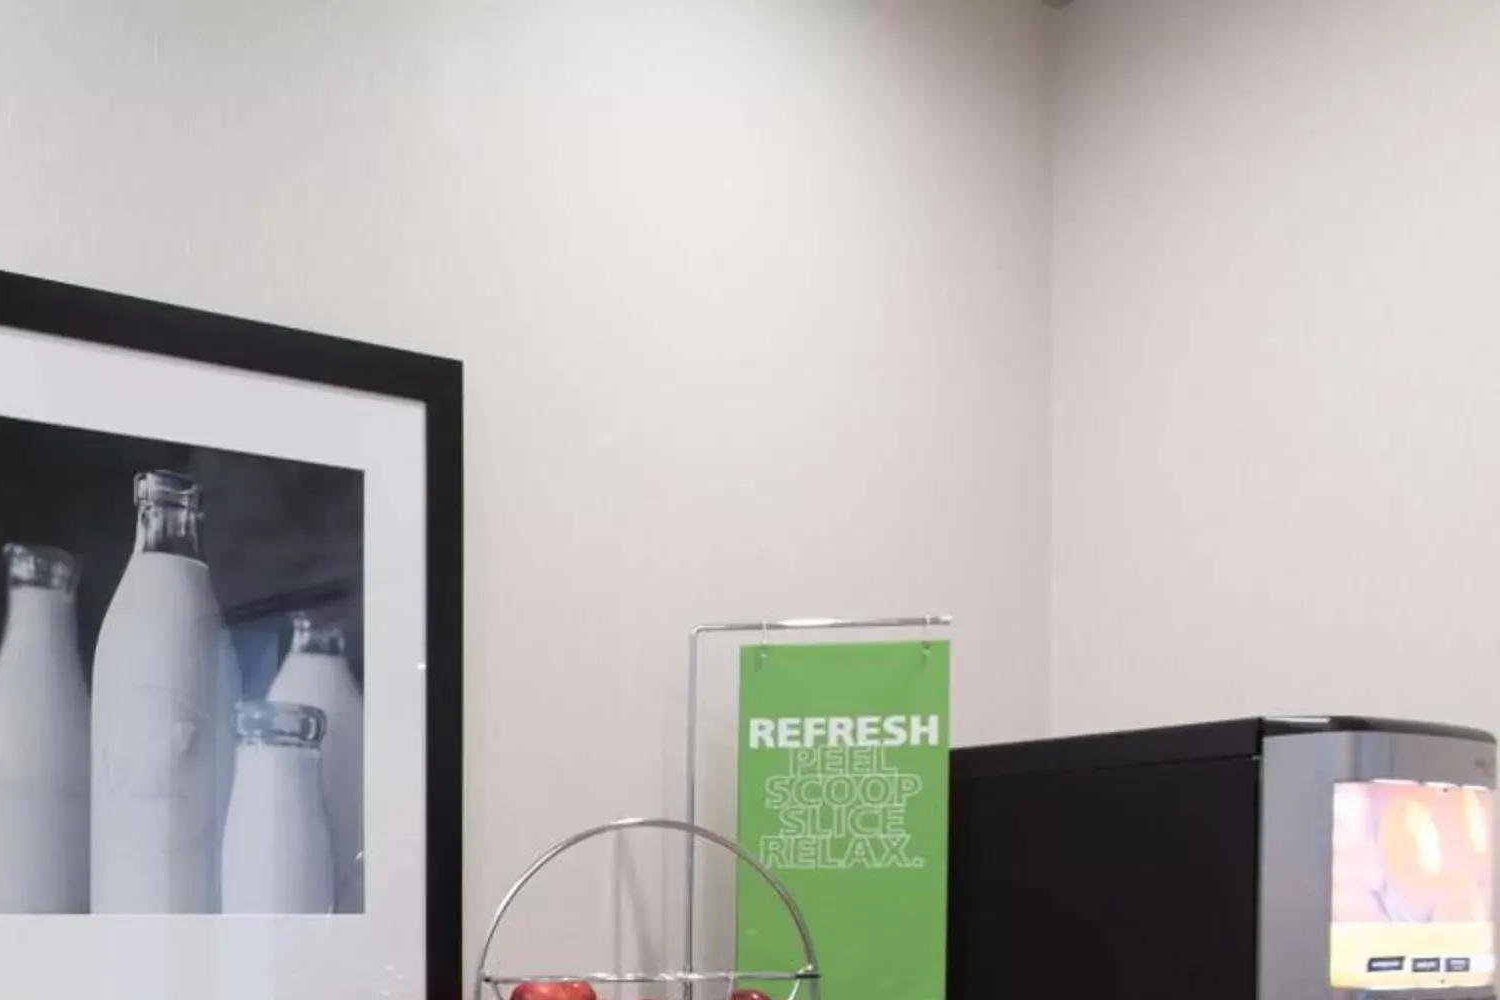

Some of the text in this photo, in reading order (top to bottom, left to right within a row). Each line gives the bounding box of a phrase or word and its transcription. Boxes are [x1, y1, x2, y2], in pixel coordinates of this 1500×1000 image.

[749, 714, 939, 749] REFRESH
[789, 744, 898, 777] PEEL
[764, 772, 923, 809] SCOOP
[779, 804, 907, 838] SLICE
[760, 834, 926, 869] RELAX.
